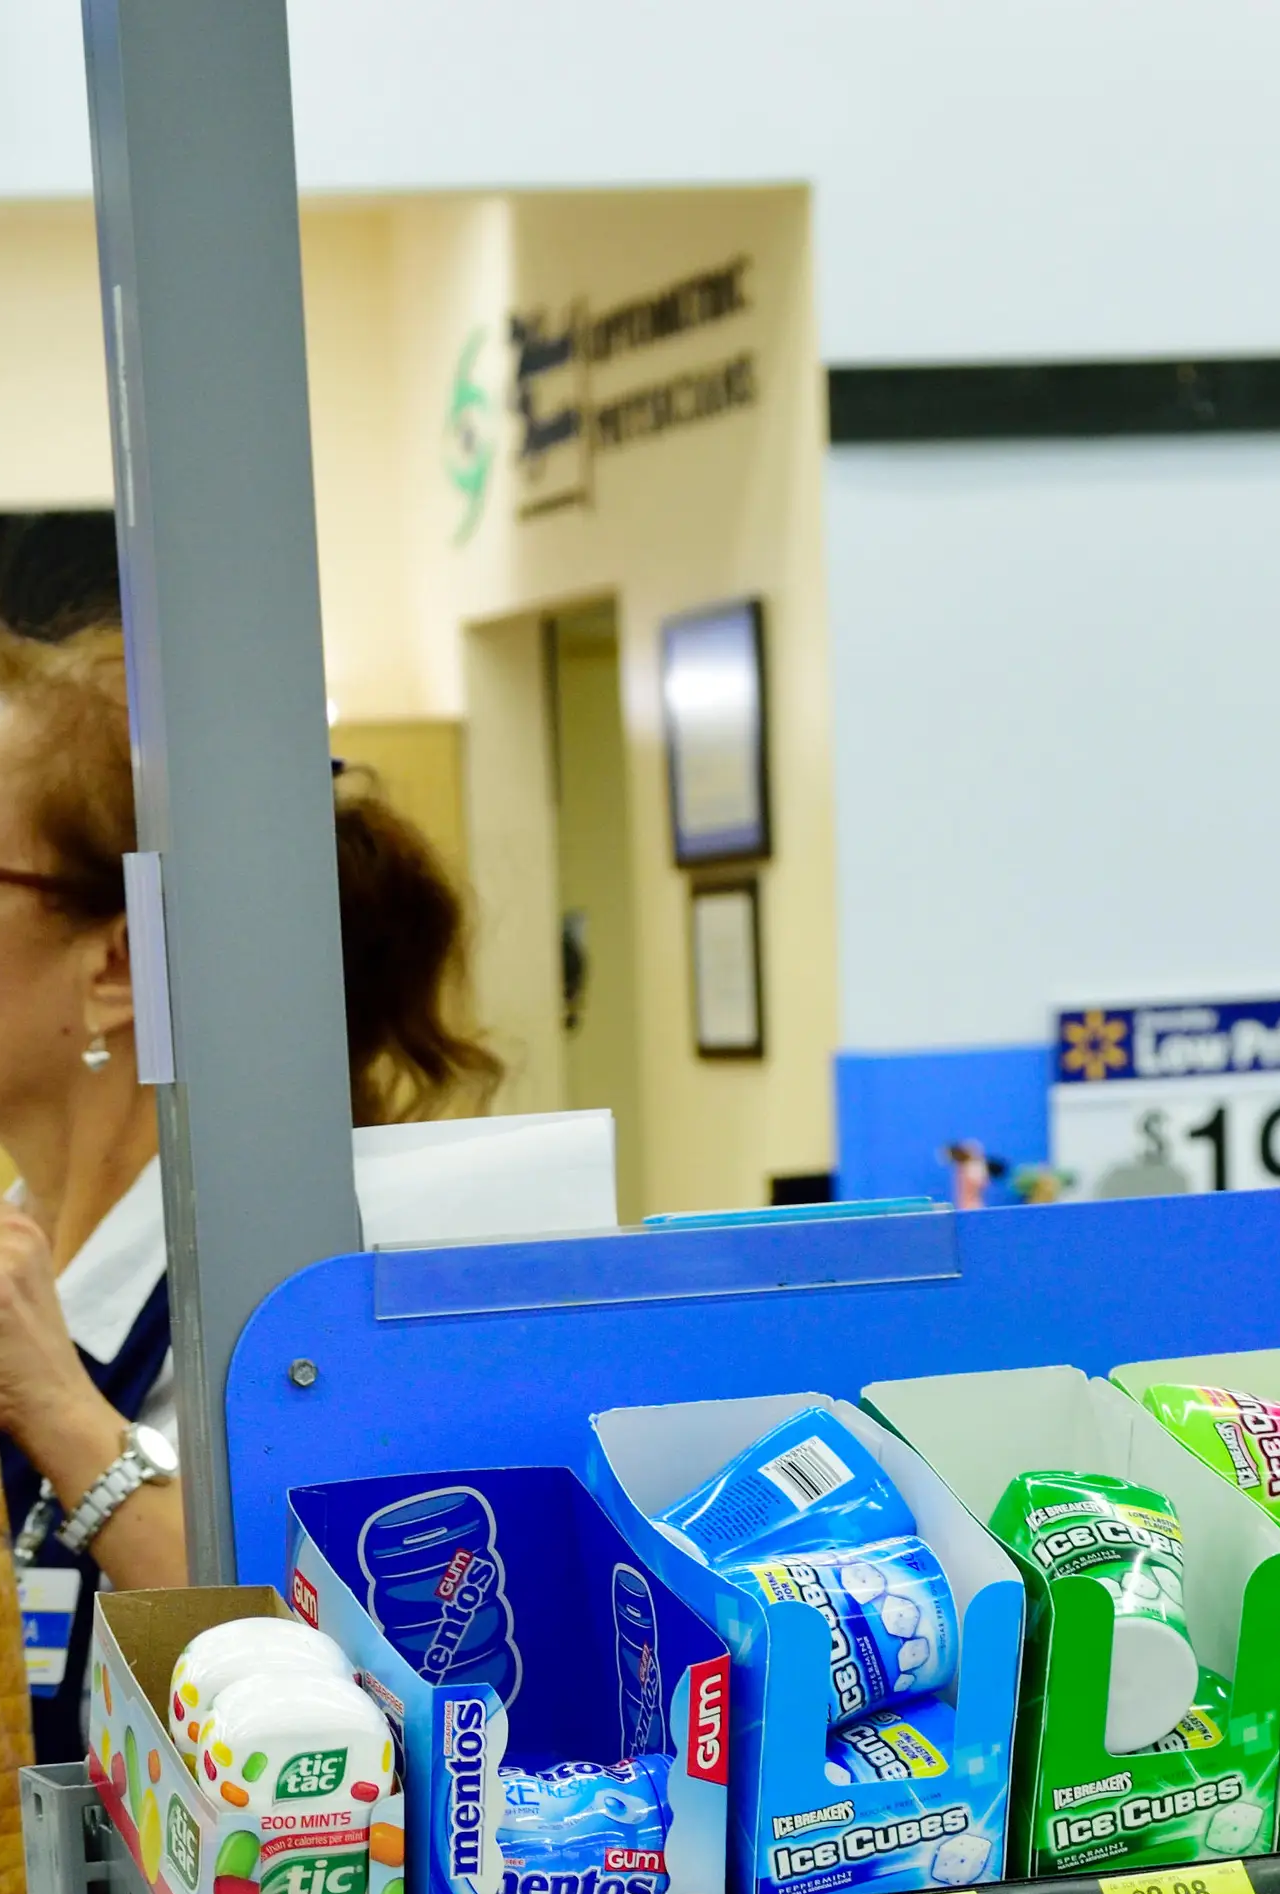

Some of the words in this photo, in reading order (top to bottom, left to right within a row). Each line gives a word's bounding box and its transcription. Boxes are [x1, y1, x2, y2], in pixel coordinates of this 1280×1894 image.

[1135, 1025, 1228, 1078] Low
[449, 1698, 489, 1881] mentos
[260, 1815, 299, 1832] 200
[300, 1811, 352, 1829] MINTS
[796, 1801, 855, 1836] BREAKERS
